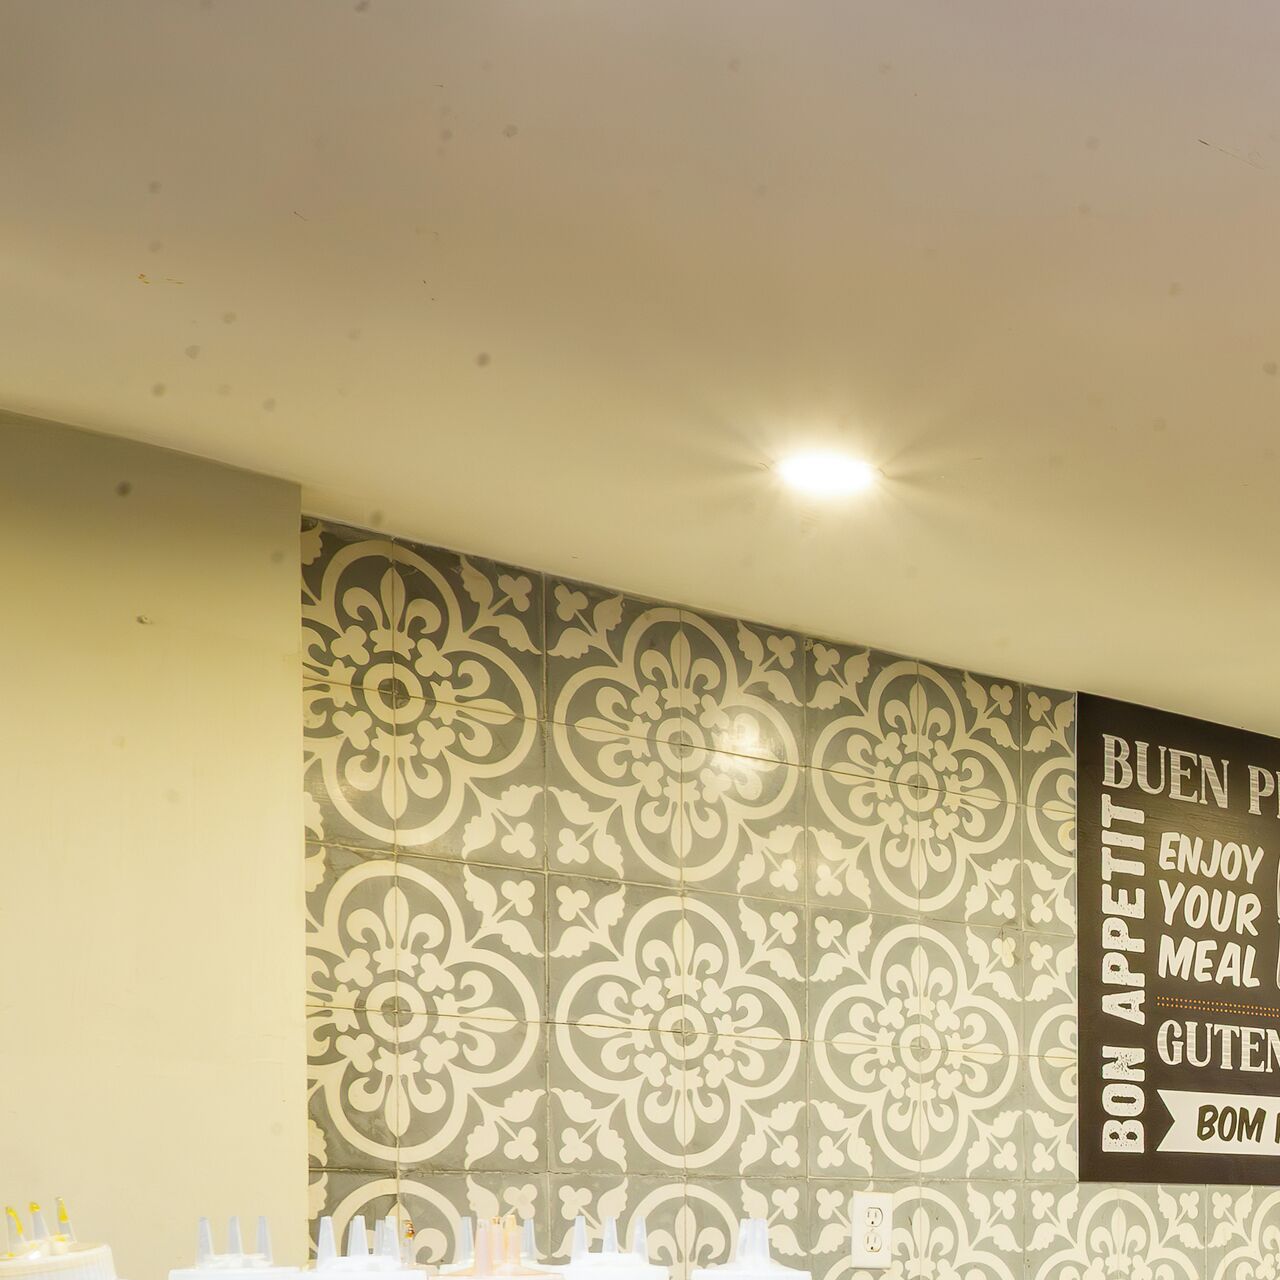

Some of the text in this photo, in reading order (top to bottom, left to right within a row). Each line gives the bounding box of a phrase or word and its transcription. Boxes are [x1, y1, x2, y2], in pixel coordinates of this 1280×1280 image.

[1102, 734, 1229, 809] BUEN
[1159, 832, 1263, 884] ENJOY
[1158, 879, 1261, 935] YOUR
[1102, 795, 1146, 1153] BON APPETIT
[1158, 935, 1260, 987] MEAL
[1196, 1104, 1264, 1142] BOM
